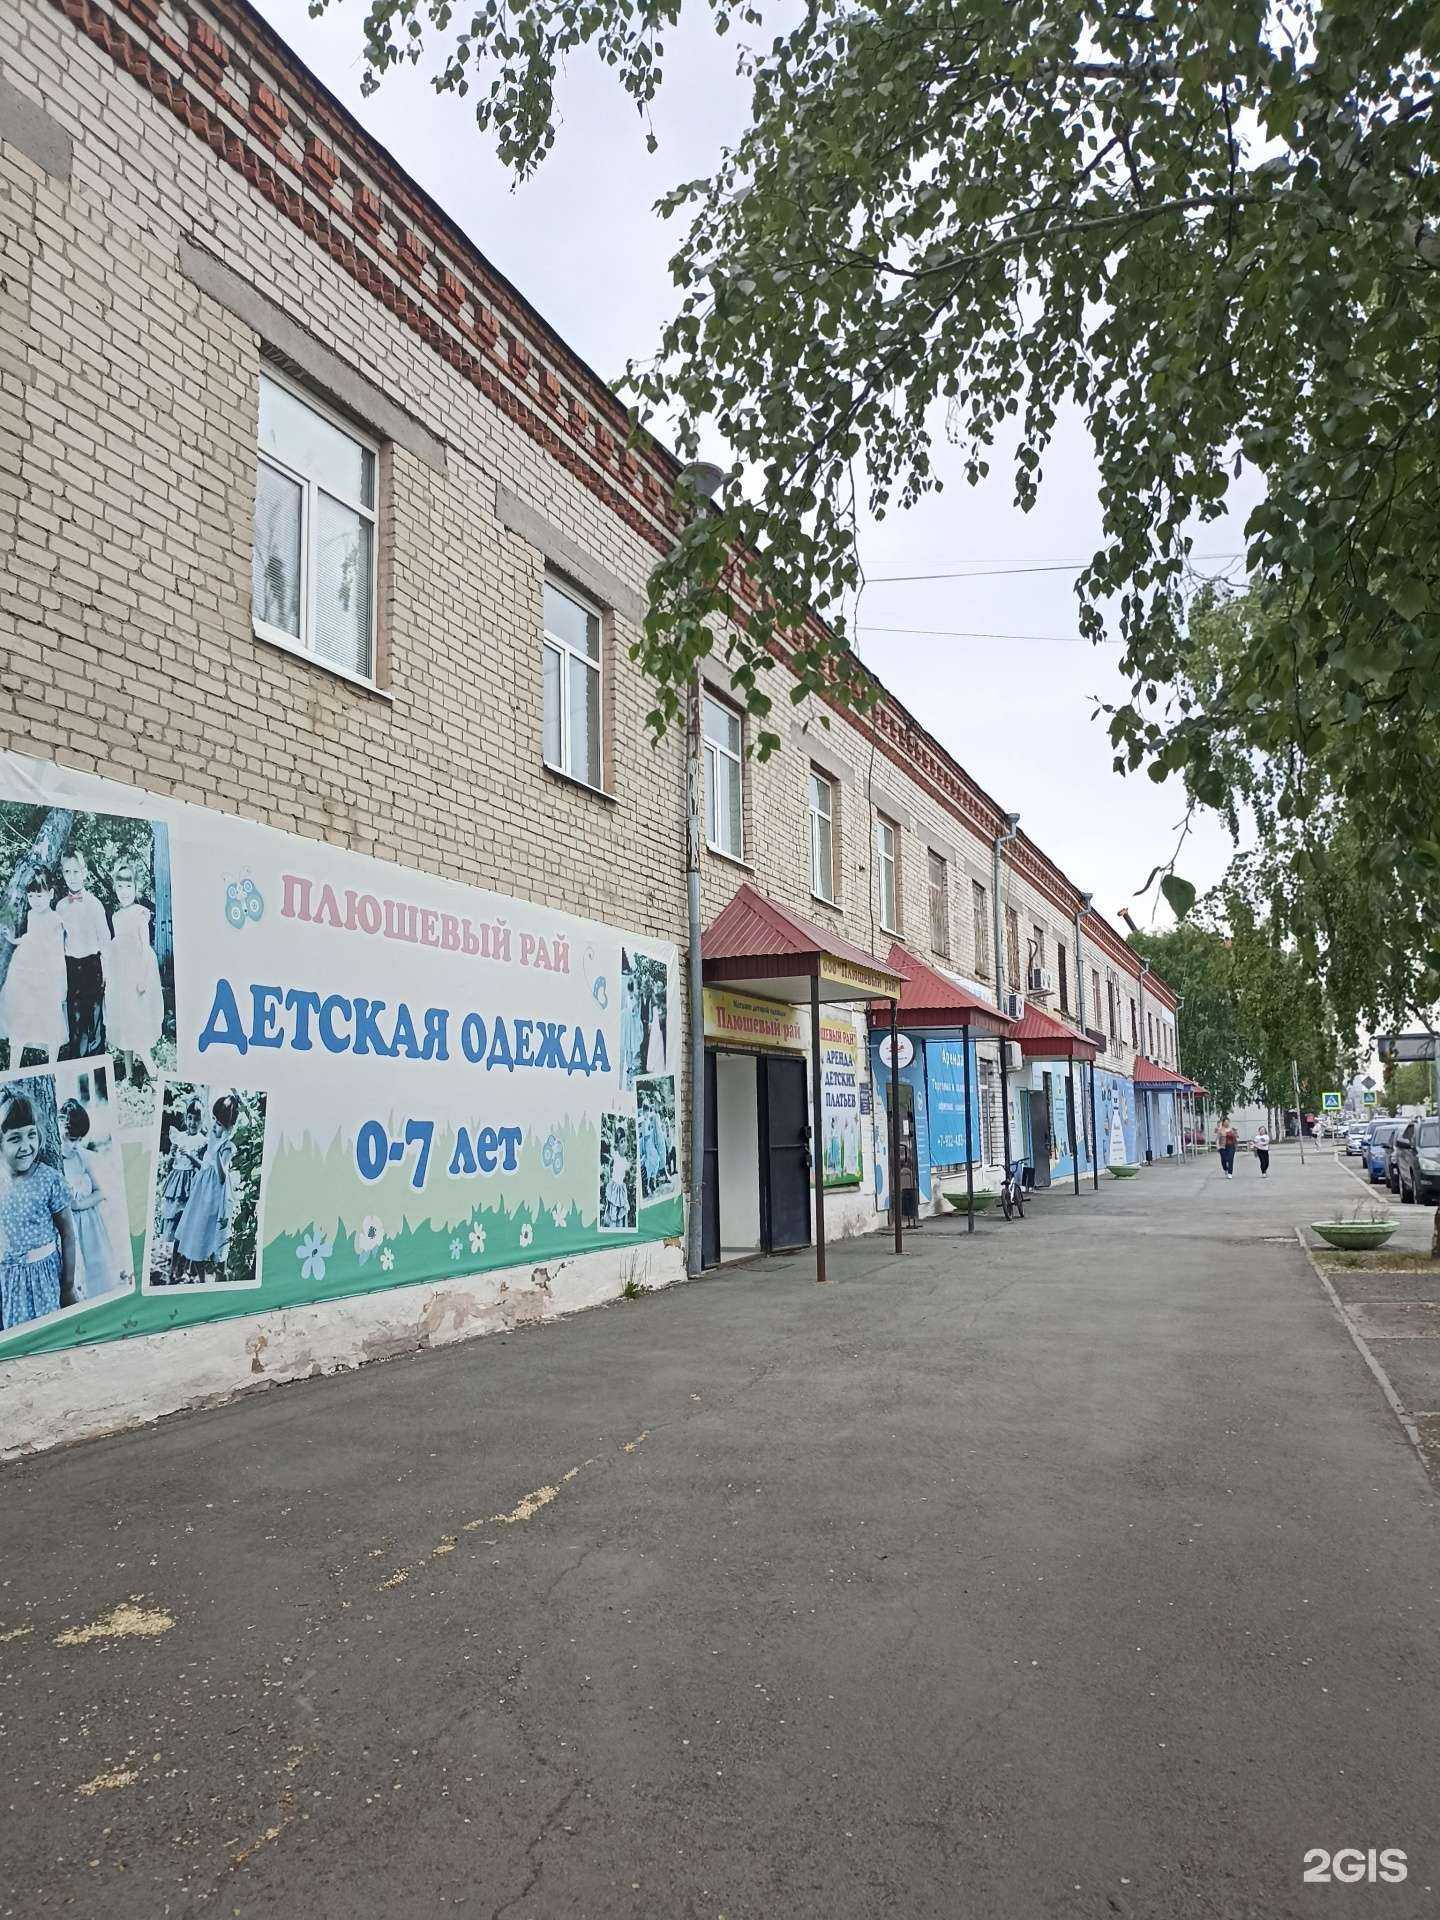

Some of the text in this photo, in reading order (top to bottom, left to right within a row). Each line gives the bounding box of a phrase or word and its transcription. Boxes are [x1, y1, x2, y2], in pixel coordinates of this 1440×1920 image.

[280, 874, 571, 975] ПЛЮШЕВЫЙ РАЙ
[198, 978, 611, 1077] ДЕТСКАЯ ОДЕЖДА
[715, 1005, 801, 1041] Плюшевый рай
[826, 1049, 853, 1067] АРЕНДА
[825, 1071, 856, 1087] ДЕТСКИХ
[826, 1091, 856, 1108] ПЛАТЬЕВ
[356, 1118, 522, 1188] 0-7 лет
